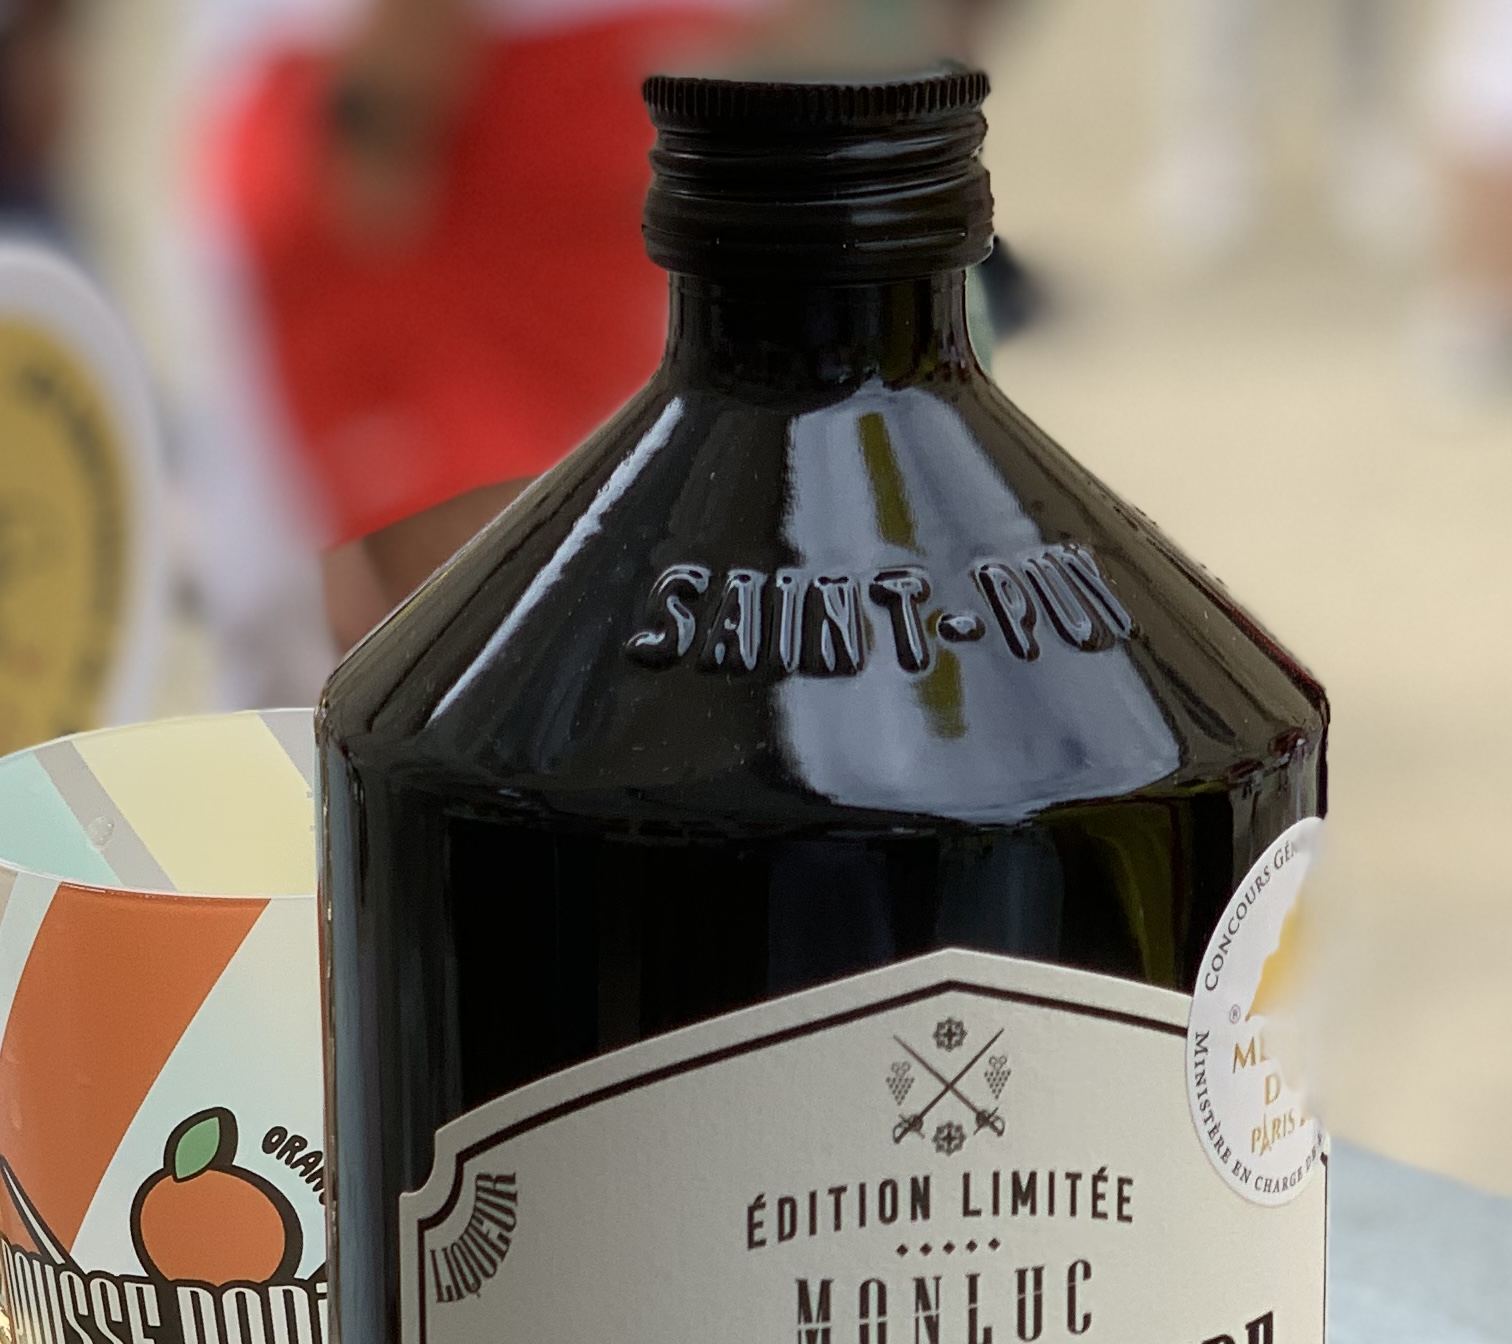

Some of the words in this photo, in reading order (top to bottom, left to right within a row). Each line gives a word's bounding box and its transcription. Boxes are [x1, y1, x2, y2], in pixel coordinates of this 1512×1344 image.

[622, 541, 1132, 677] SAINT-PUY
[1204, 865, 1271, 992] CONCOURS
[1193, 1030, 1233, 1165] MINISTÈRE
[1232, 1160, 1253, 1184] EN
[1254, 1165, 1303, 1194] CHARGE
[429, 1171, 519, 1305] LIQUEUR
[746, 1173, 932, 1252] ÉDITION
[962, 1165, 1135, 1224] LIMITÉE
